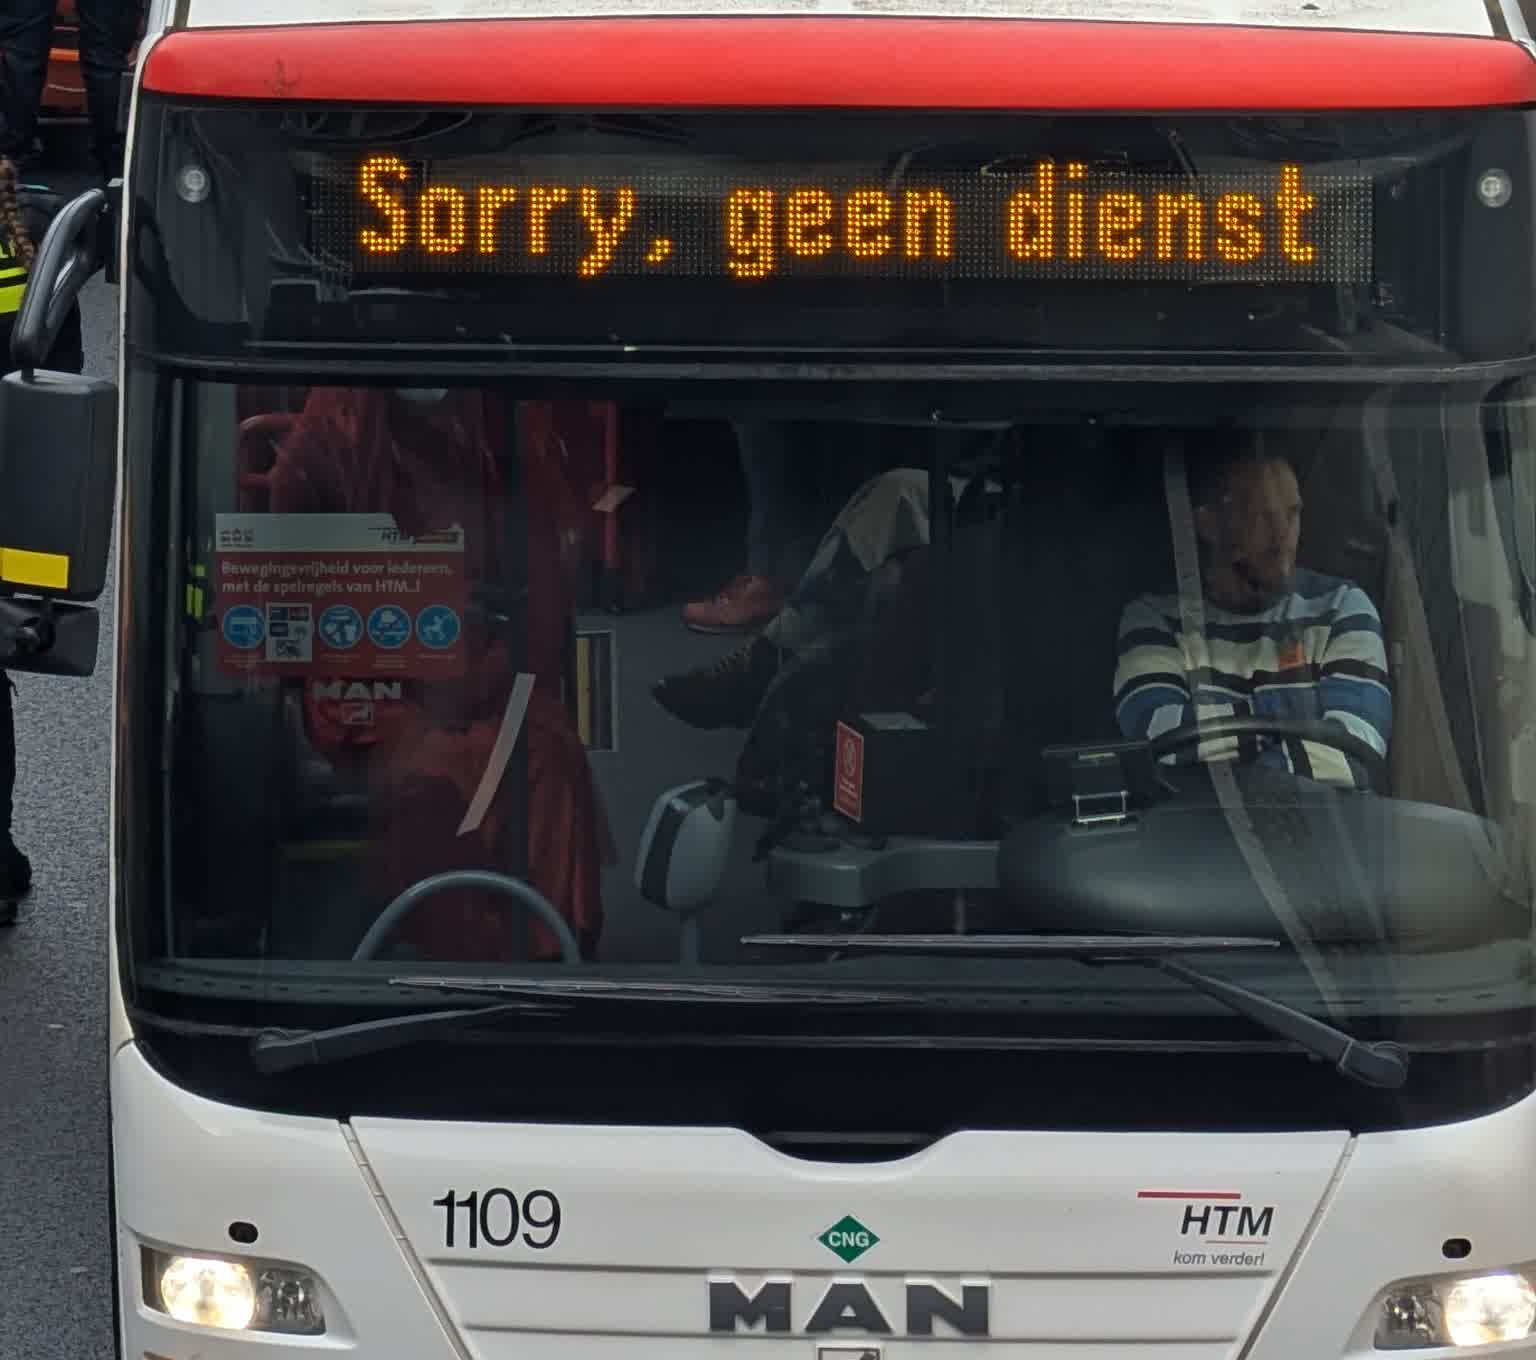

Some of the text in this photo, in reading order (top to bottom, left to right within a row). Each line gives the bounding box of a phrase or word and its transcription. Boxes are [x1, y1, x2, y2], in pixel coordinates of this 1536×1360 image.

[361, 154, 1317, 279] Sorry, geen dienst
[352, 563, 385, 575] voor
[222, 578, 251, 593] met
[254, 577, 270, 593] de
[347, 581, 373, 593] van
[433, 1187, 561, 1249] 1109
[1180, 1205, 1274, 1236] HTM
[827, 1233, 870, 1249] CNG
[1173, 1250, 1265, 1266] kom verder!
[708, 1280, 990, 1336] MAN
